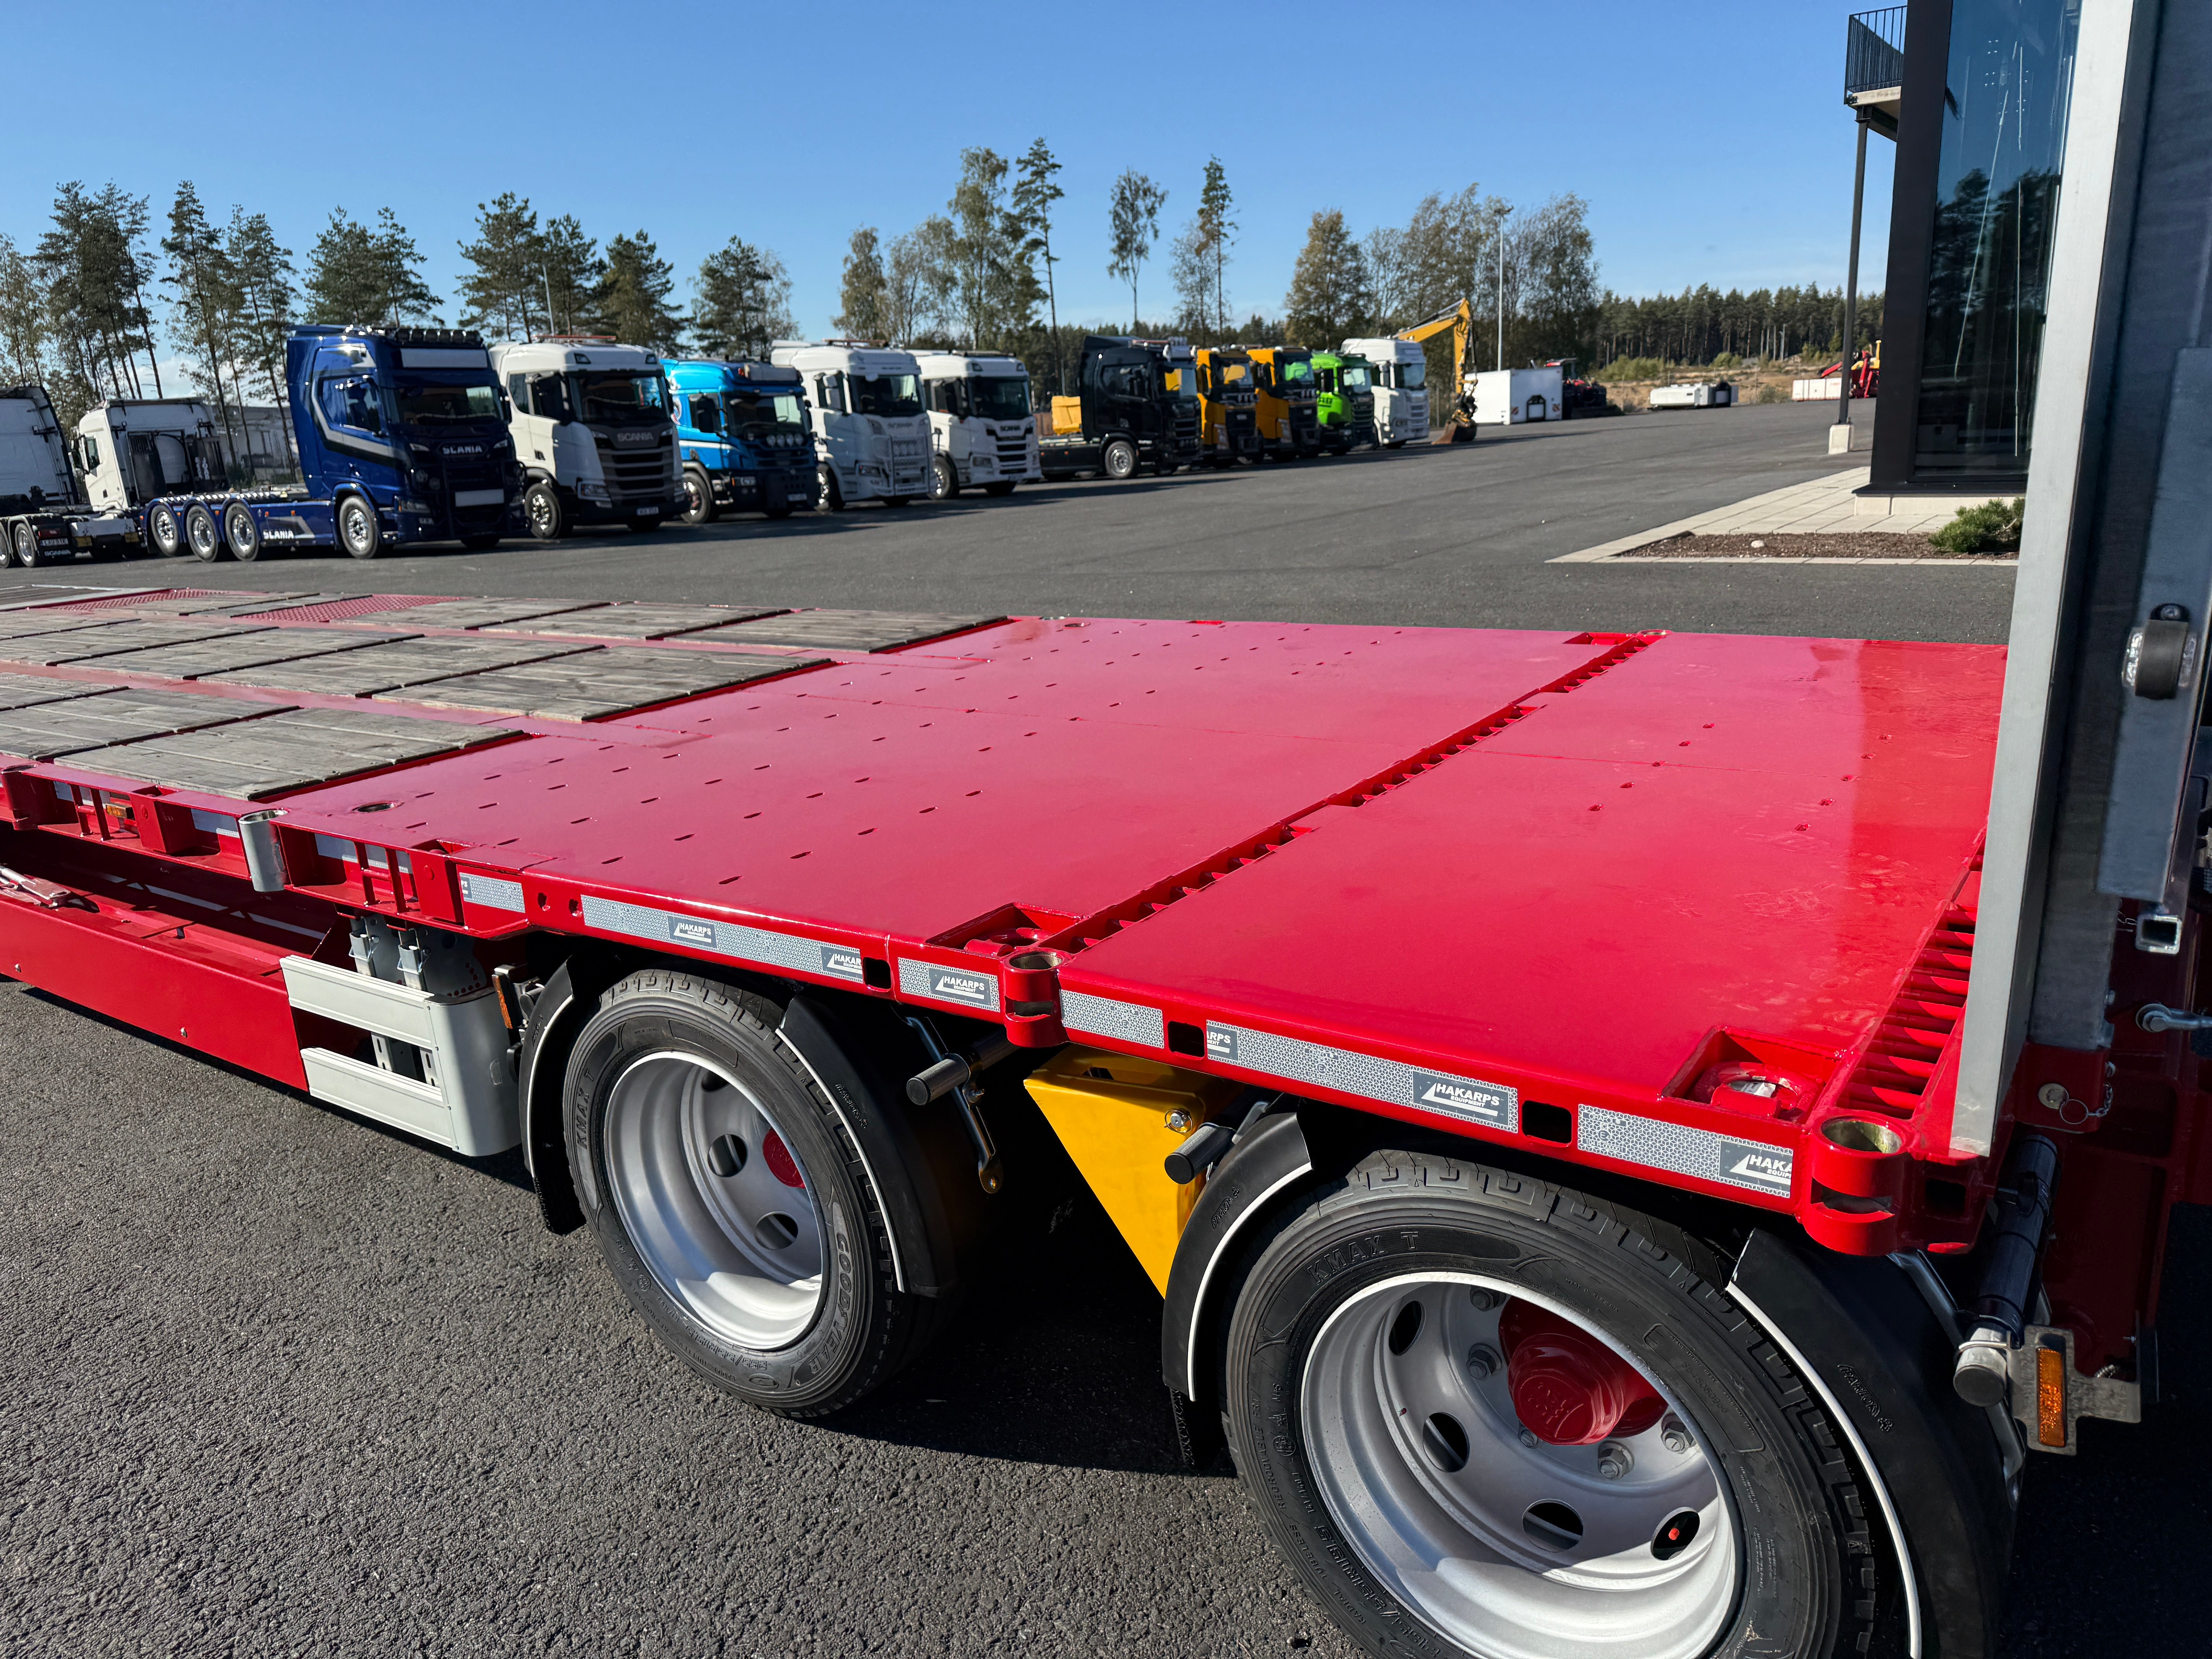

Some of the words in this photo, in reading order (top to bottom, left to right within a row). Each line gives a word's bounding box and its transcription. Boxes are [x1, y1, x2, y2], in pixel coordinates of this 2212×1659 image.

[442, 445, 483, 455] SCANIA
[263, 529, 294, 539] SCANIA
[680, 922, 712, 936] HAKARPS
[944, 975, 985, 991] HAKARPS
[576, 1087, 590, 1150] KMAX
[584, 1068, 594, 1082] T
[1436, 1083, 1500, 1106] HAKARPS
[1450, 1096, 1486, 1108] EQUIPMENT
[1307, 1235, 1388, 1285] KMAX
[1400, 1231, 1418, 1250] T
[807, 1232, 852, 1374] GOODYEAR
[1255, 1426, 1286, 1509] REGROOVABLE
[1289, 1523, 1327, 1579] TUBELESS
[1334, 1589, 1367, 1625] RADIAL
